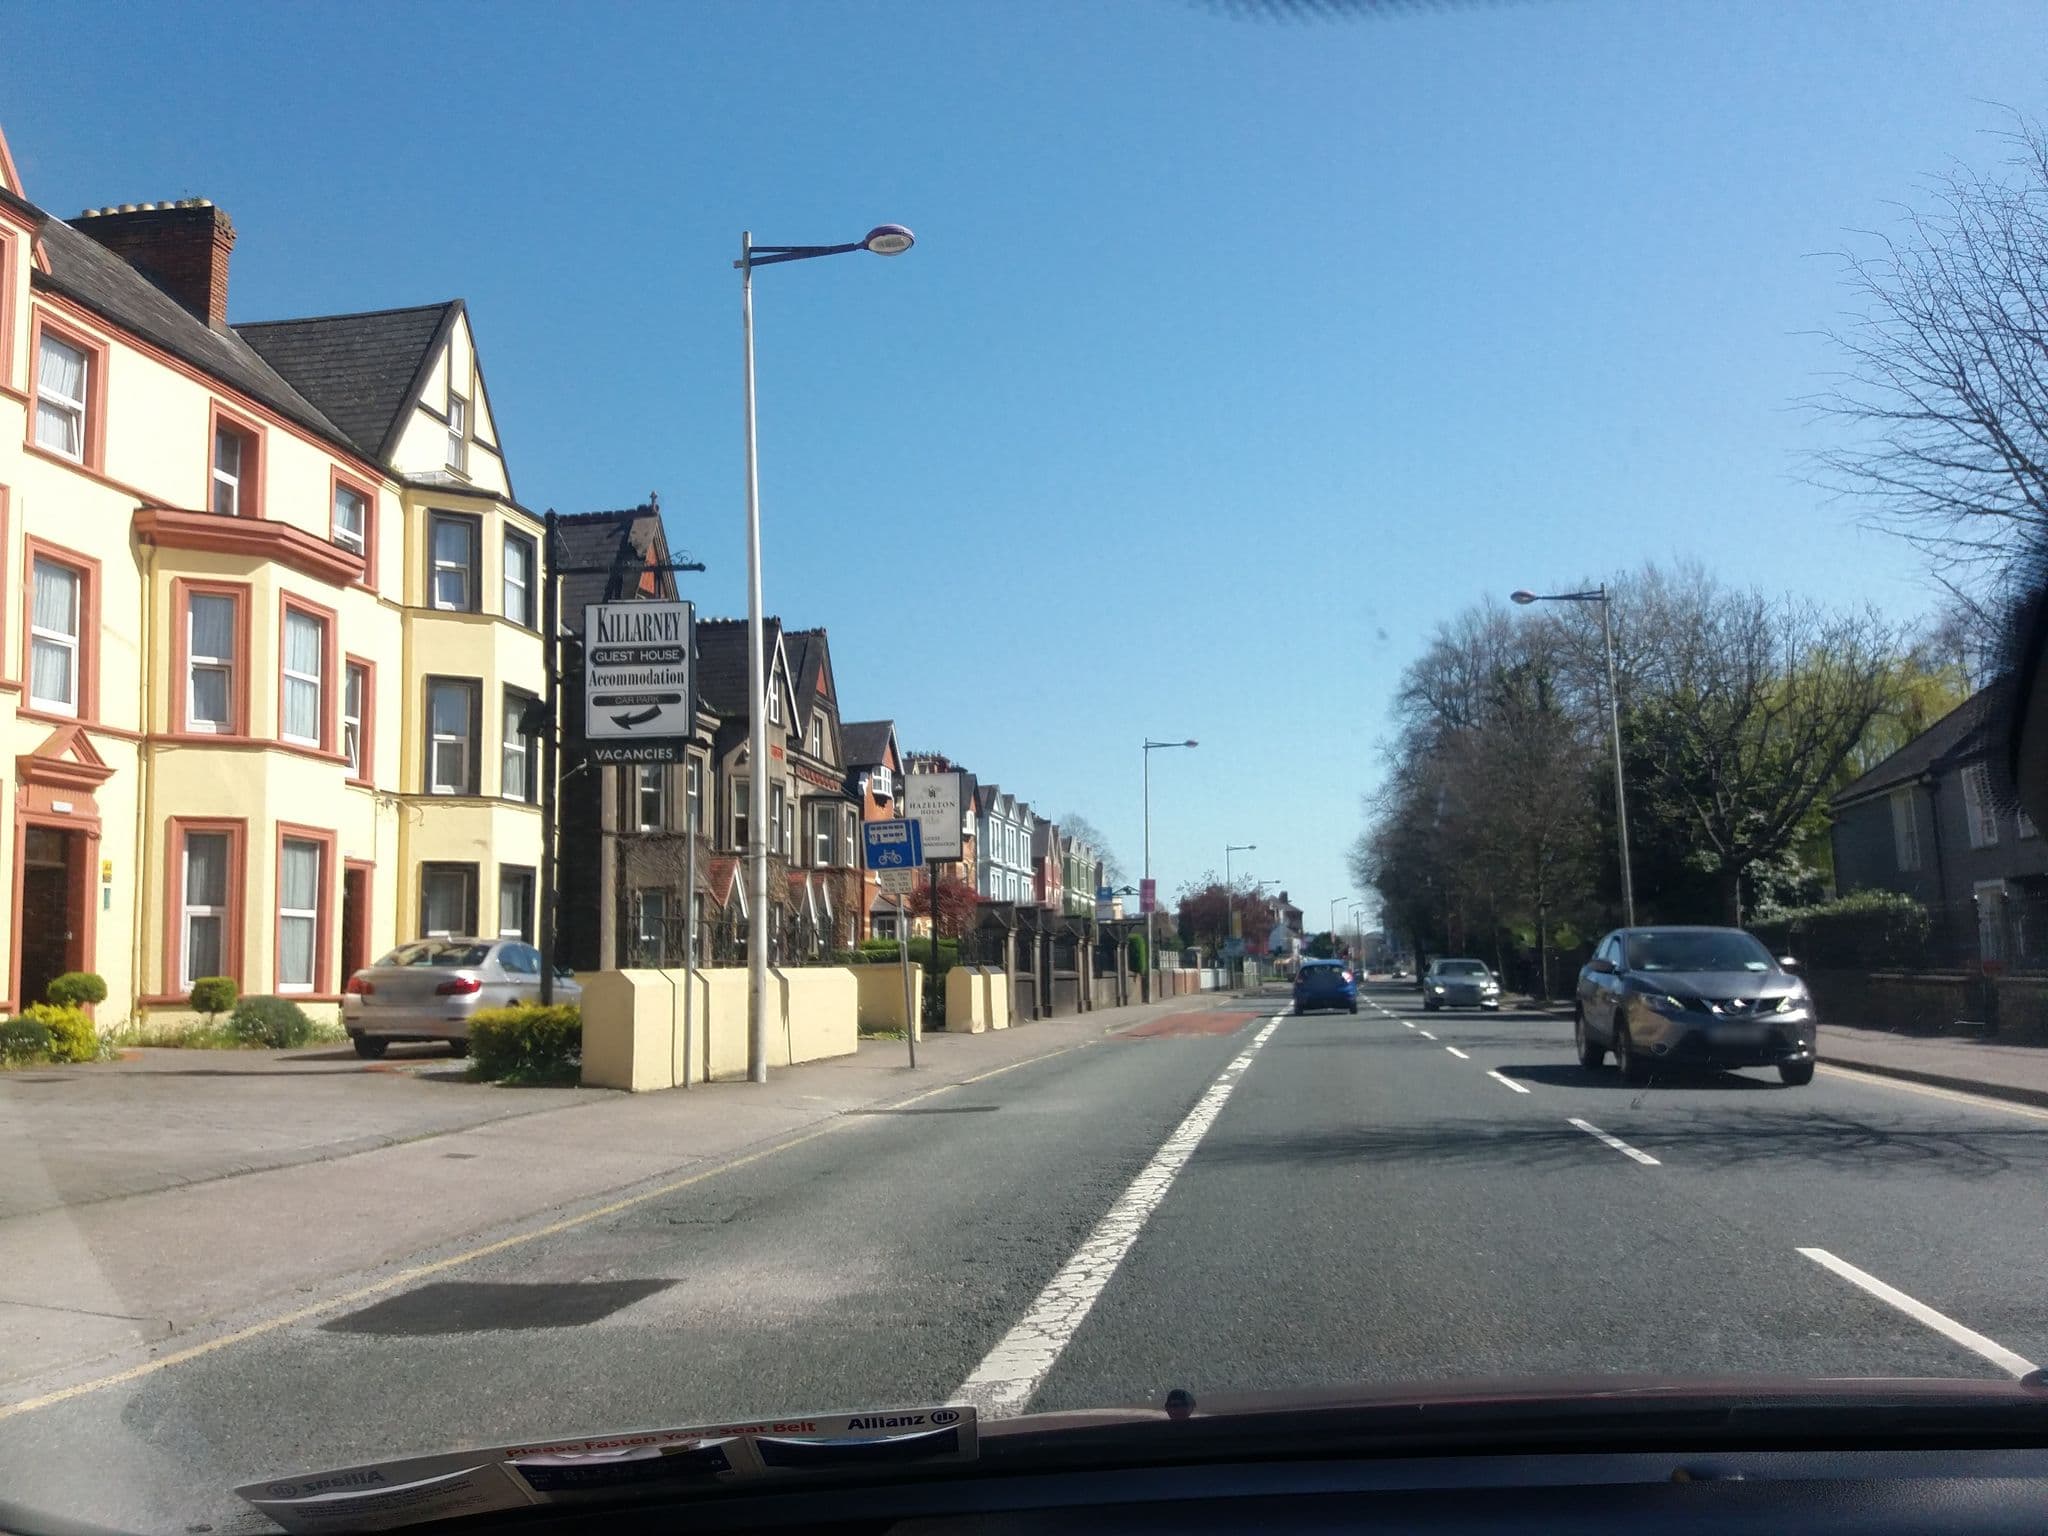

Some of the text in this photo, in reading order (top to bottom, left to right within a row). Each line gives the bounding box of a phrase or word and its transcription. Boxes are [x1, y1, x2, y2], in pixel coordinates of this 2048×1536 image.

[597, 607, 680, 642] KILLARNEY
[595, 649, 680, 662] GUEST HOUSE
[588, 668, 684, 687] Accommodation
[615, 695, 660, 705] CAR PARK
[595, 748, 673, 760] VACANCIES
[909, 801, 956, 809] HAZELTON
[848, 1415, 925, 1430] Allianz
[507, 1443, 579, 1458] Please
[584, 1436, 656, 1450] Fasten
[720, 1424, 767, 1436] Seat
[773, 1422, 816, 1433] Belt
